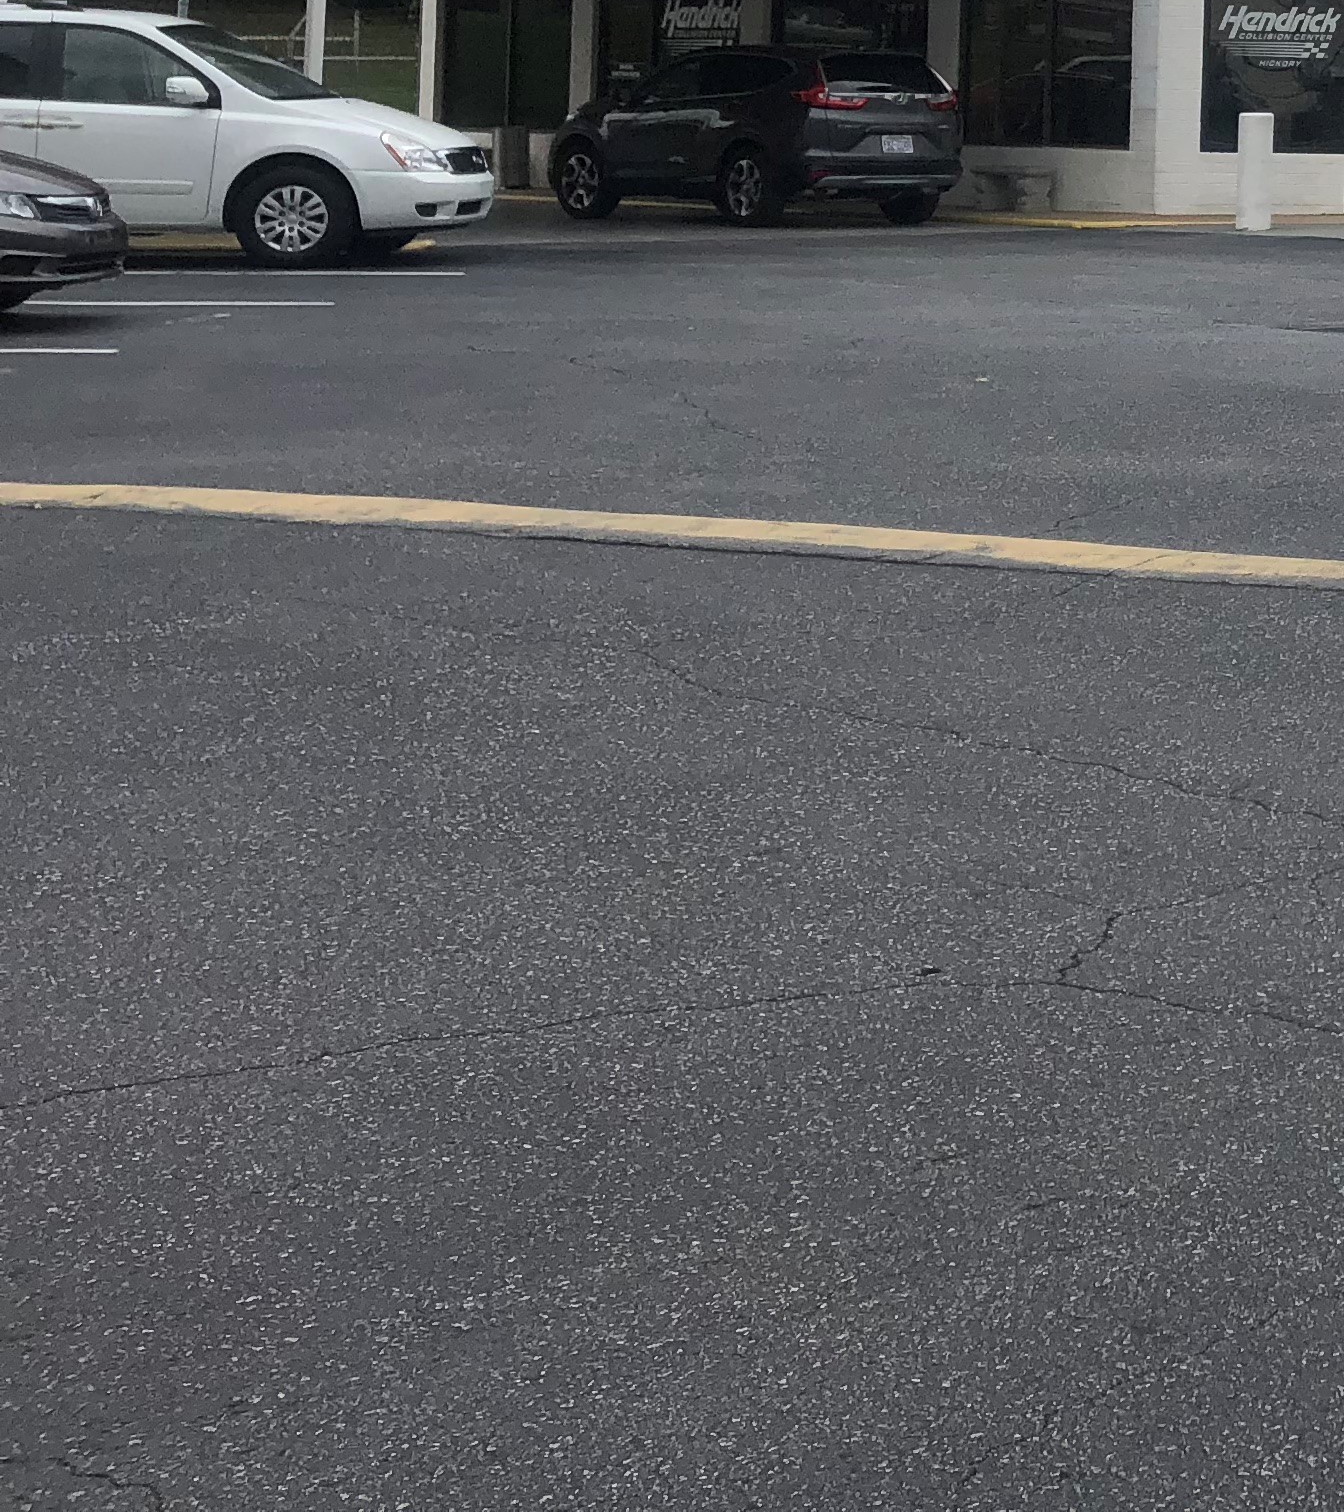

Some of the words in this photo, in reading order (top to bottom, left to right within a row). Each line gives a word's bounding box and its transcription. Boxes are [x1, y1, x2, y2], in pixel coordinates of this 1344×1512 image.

[661, 0, 741, 38] Hendrick
[1218, 5, 1342, 39] Hendrick
[1238, 32, 1292, 41] COLLISION
[1293, 33, 1333, 41] CENTER
[1258, 59, 1302, 67] HICKORY
